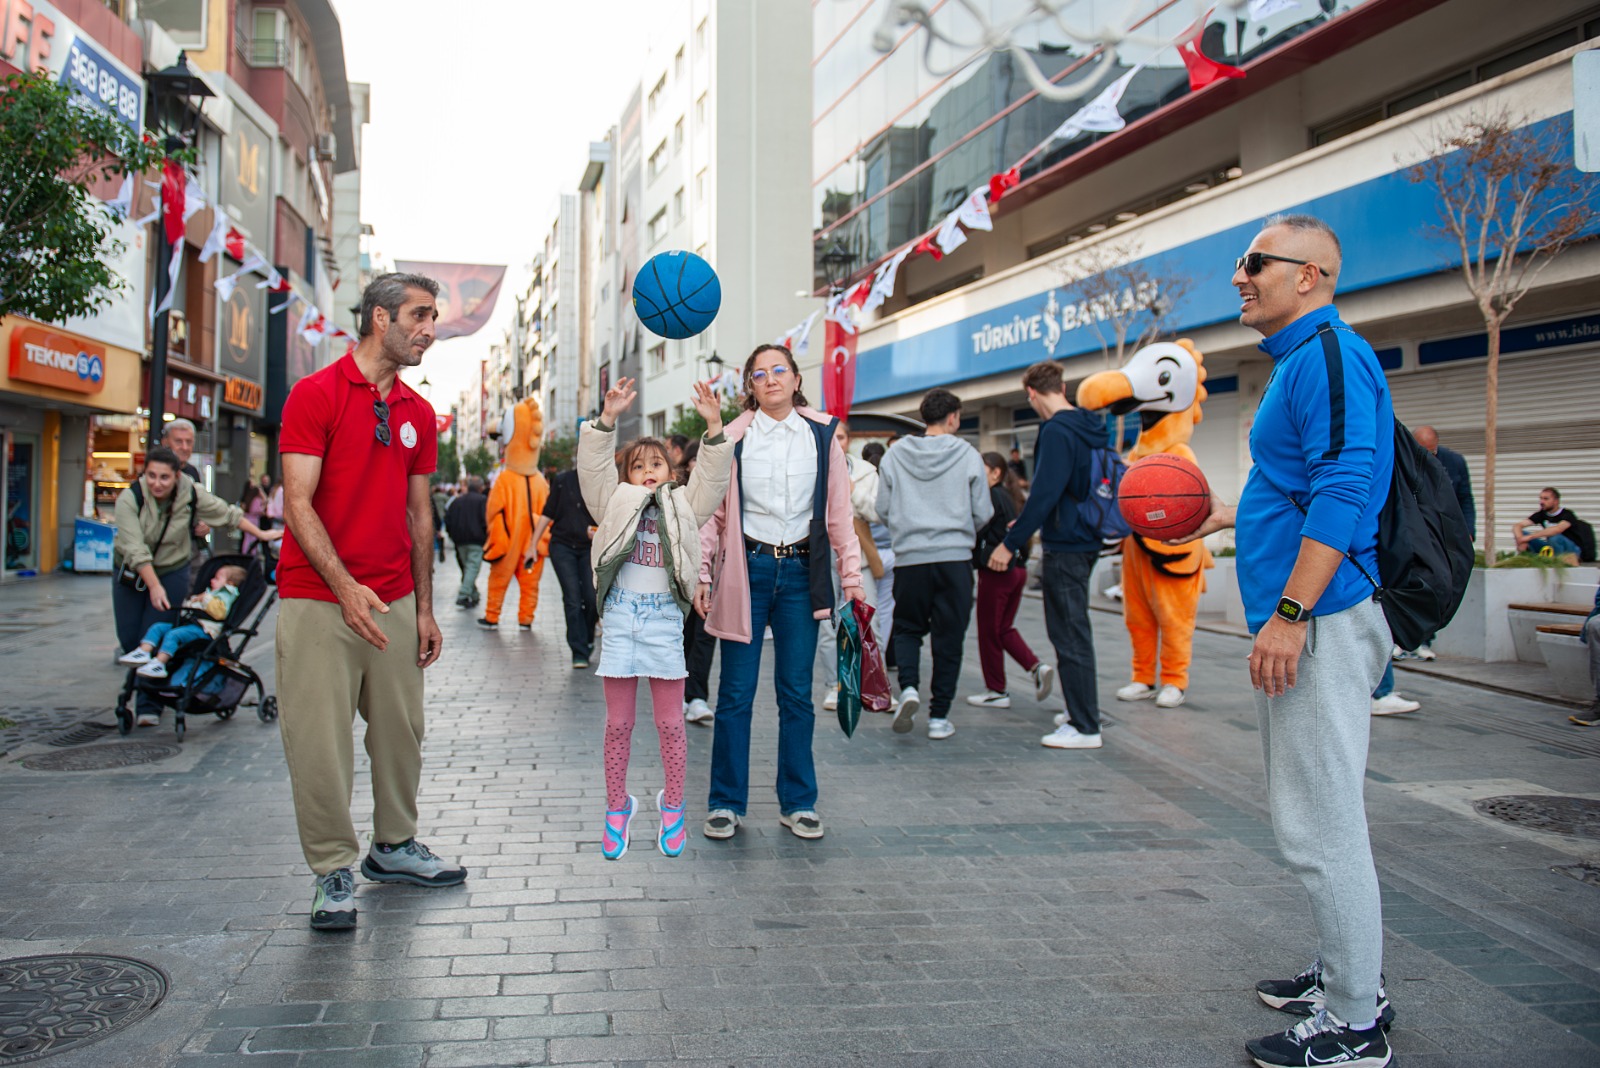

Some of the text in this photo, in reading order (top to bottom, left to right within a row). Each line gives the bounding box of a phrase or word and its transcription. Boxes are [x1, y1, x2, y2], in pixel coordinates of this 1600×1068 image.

[70, 44, 98, 94] 368
[98, 68, 119, 106] 88
[118, 84, 138, 121] 88
[971, 314, 1042, 355] TÜRKİYE
[24, 342, 103, 380] TEKNOSA
[224, 374, 263, 411] MEZZO
